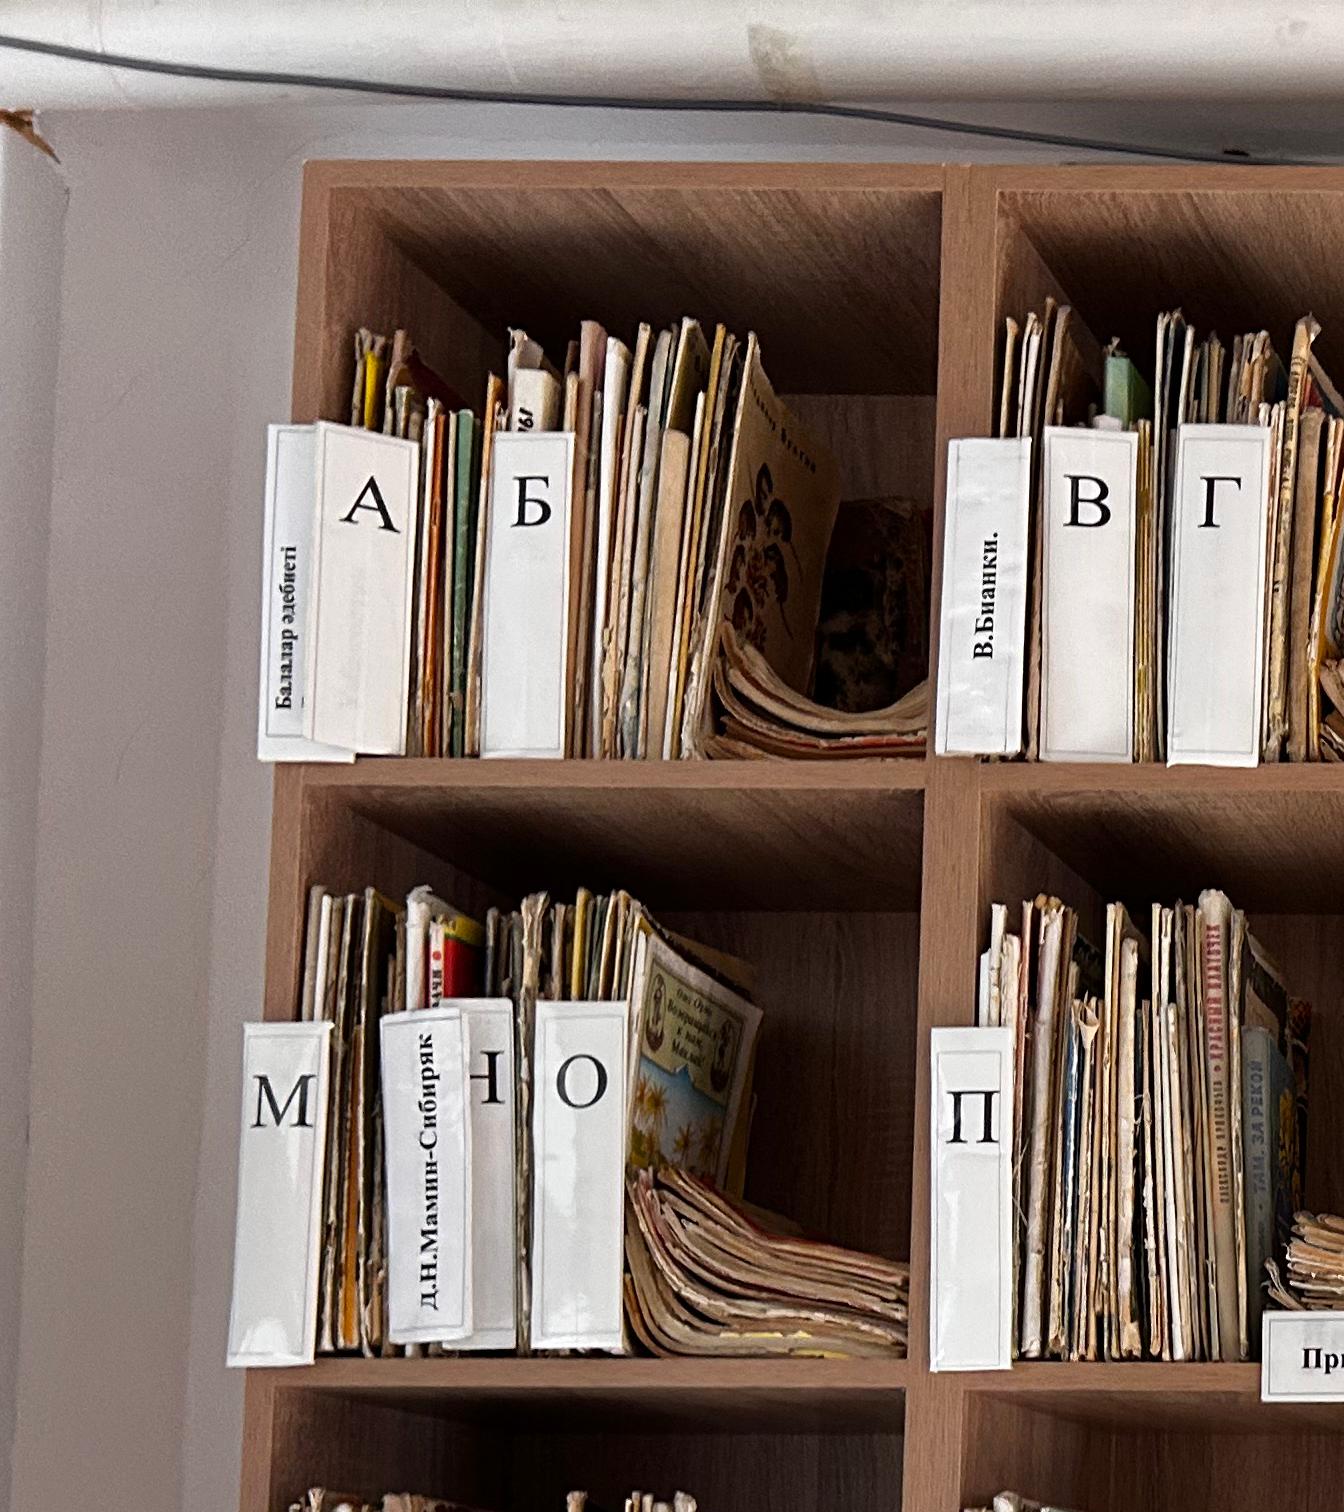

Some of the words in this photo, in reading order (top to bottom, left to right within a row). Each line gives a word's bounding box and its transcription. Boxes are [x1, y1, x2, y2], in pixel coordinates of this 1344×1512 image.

[339, 476, 400, 533] А
[511, 476, 552, 527] Б
[1063, 474, 1111, 528] В
[1198, 476, 1242, 528] Г
[280, 545, 298, 624] әдебиеті
[973, 531, 999, 660] В.Бианки.
[275, 624, 294, 712] Балалар
[250, 1075, 316, 1129] М
[556, 1053, 608, 1108] О
[946, 1090, 1000, 1144] П
[417, 1032, 441, 1311] Д.Н.Мамин-Сибиряк
